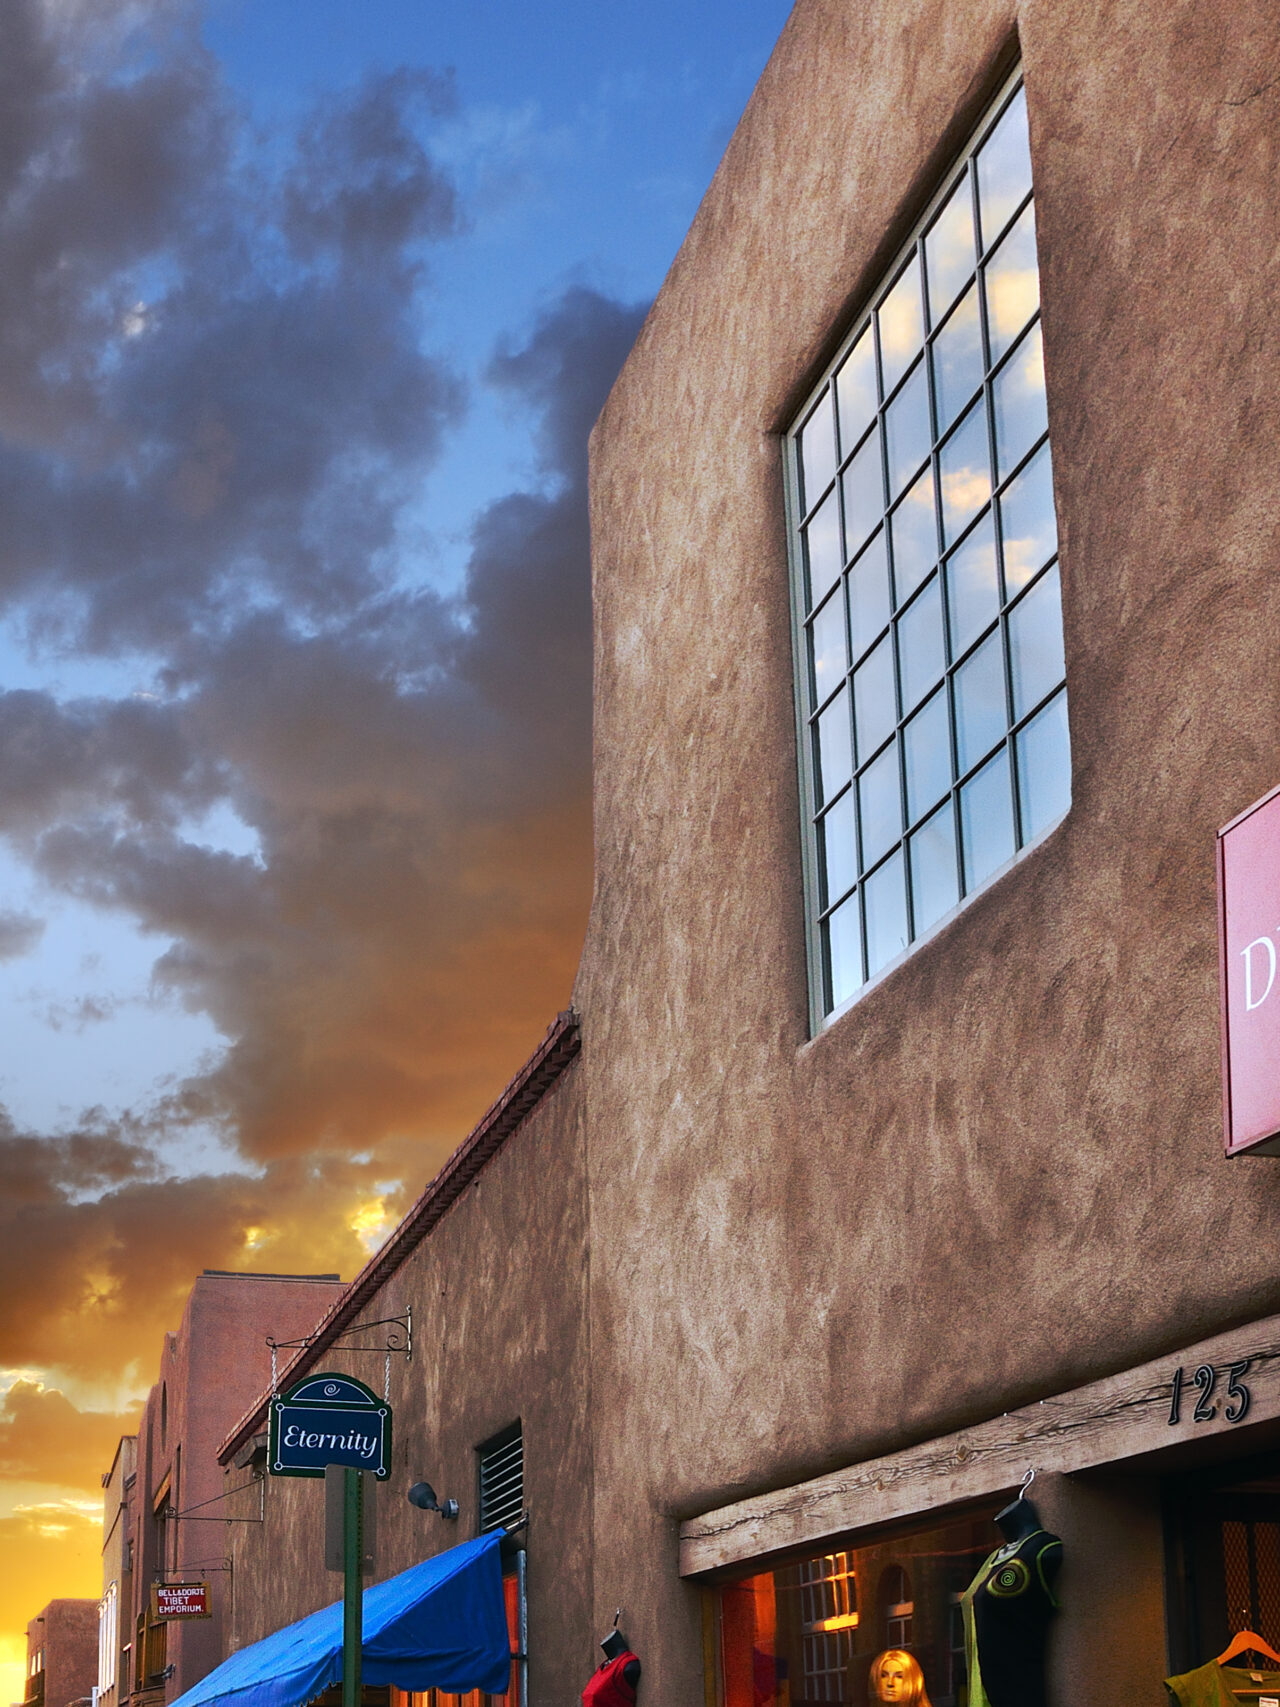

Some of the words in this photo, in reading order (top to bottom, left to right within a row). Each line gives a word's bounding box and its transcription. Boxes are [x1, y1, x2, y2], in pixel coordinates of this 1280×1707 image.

[1240, 925, 1280, 1012] D
[1167, 1360, 1250, 1426] 125
[283, 1425, 377, 1458] Eternity
[163, 1596, 190, 1606] TIBET
